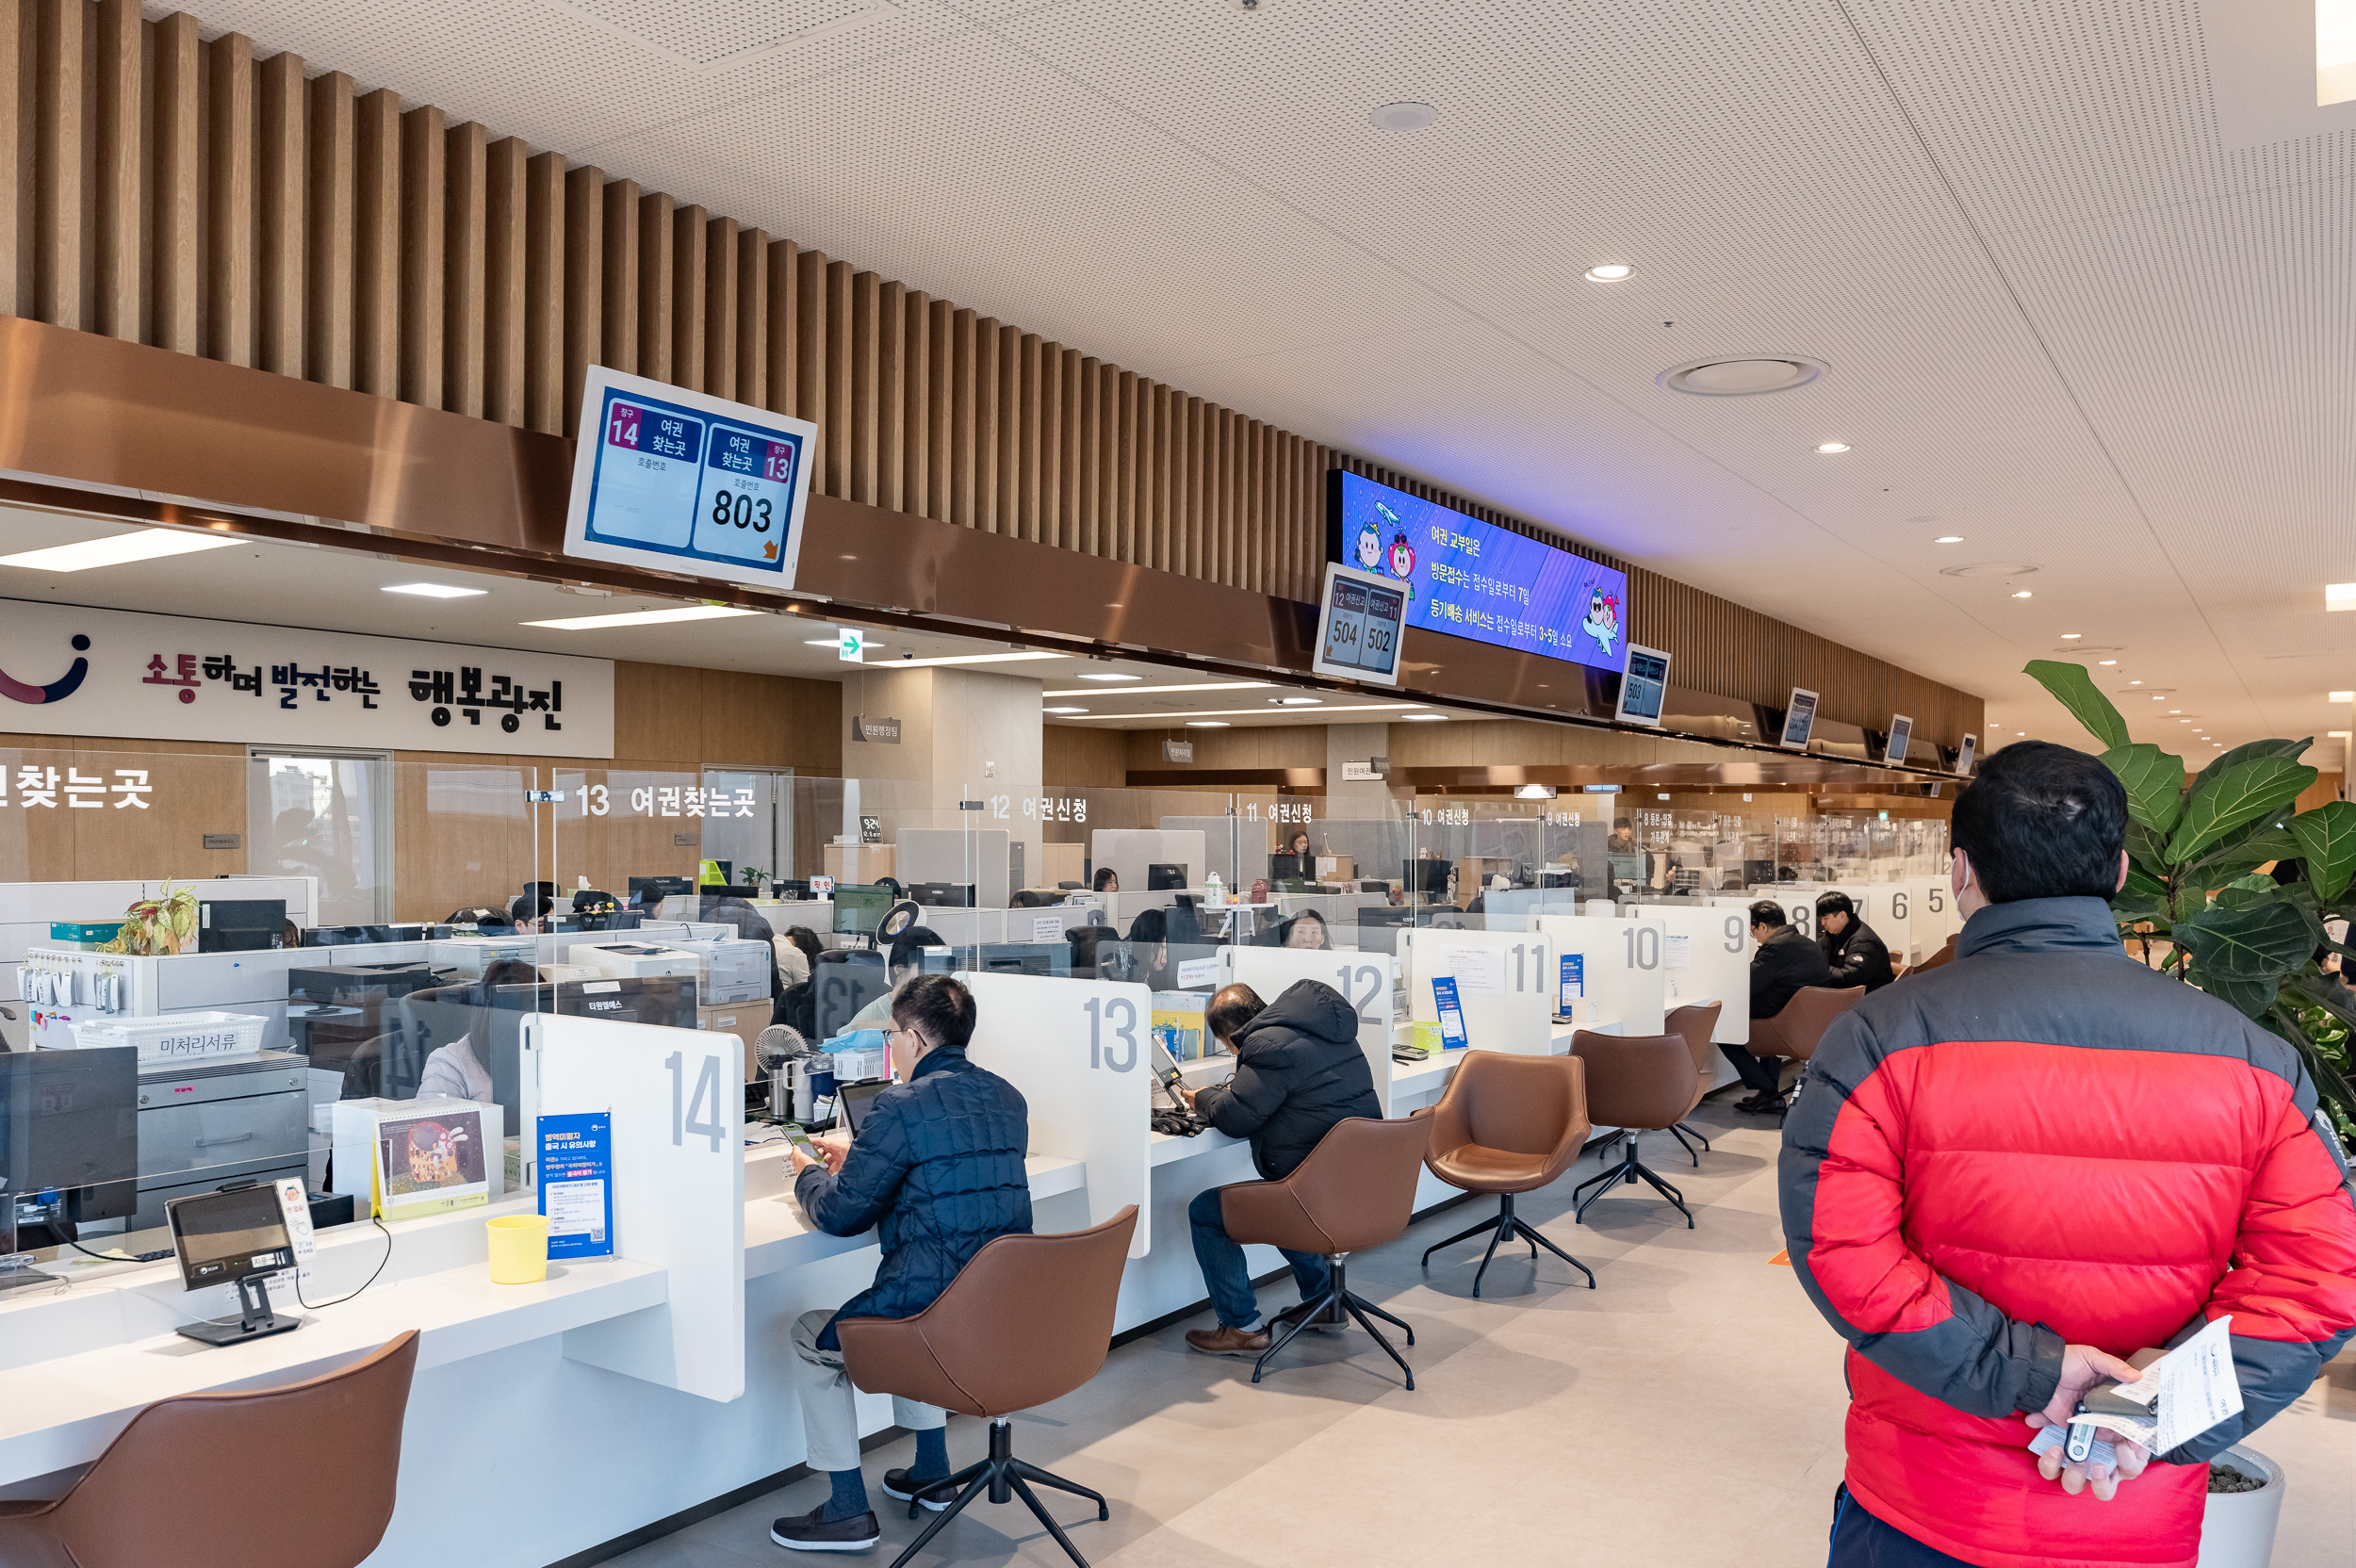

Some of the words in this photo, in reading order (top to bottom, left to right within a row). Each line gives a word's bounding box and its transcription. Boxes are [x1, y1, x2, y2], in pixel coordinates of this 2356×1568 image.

[621, 408, 634, 418] 창구
[613, 419, 638, 446] 14
[661, 419, 683, 438] 여권
[652, 435, 686, 457] 찾는곳
[729, 436, 750, 453] 여권
[774, 445, 786, 455] 창구
[637, 457, 666, 471] 호출번호
[722, 451, 753, 471] 찾는곳
[767, 456, 789, 480] 13
[733, 478, 760, 491] 호출번호
[712, 489, 773, 532] 803
[1431, 526, 1448, 547] 여권
[1449, 531, 1481, 557] 교부일은
[1431, 562, 1469, 589] 방문접수는
[1472, 573, 1516, 602] 접수일로부터
[1517, 587, 1530, 605] 7일
[1333, 592, 1345, 607] 12
[1389, 605, 1399, 619] 11
[1431, 598, 1463, 623] 등기배송
[1464, 608, 1495, 630] 서비스는
[1496, 614, 1537, 641] 접수일로부터
[1539, 626, 1558, 646] 3~5일
[1560, 631, 1573, 648] 소요
[1333, 619, 1358, 645] 504
[1367, 628, 1391, 652] 502
[142, 653, 262, 704] 소통하며
[271, 662, 381, 709] 발전하는
[408, 666, 562, 733] 행복광진
[1628, 682, 1642, 700] 503
[865, 725, 898, 737] 민원행정팀
[1348, 767, 1371, 776] 민원여권
[0, 764, 153, 809] 찾는곳
[576, 784, 610, 816] 13
[630, 786, 756, 818] 여권찾는곳
[990, 794, 1010, 819] 12
[1023, 796, 1087, 823] 여권신청
[1247, 803, 1258, 822] 11
[1268, 803, 1313, 824] 여권신청
[1422, 808, 1432, 825] 10
[1437, 808, 1469, 825] 여권신청
[1547, 810, 1553, 826] 9
[1556, 811, 1580, 827] 여권신청
[1644, 812, 1649, 826] 8
[1892, 892, 1907, 920] 6
[1929, 888, 1943, 913] 5
[1724, 915, 1744, 954] 9
[1792, 906, 1810, 939] 8
[1622, 927, 1659, 970] 10
[1512, 943, 1545, 993] 11
[1336, 965, 1383, 1025] 12
[160, 1034, 237, 1055] 미처리서류
[1084, 996, 1138, 1073] 13
[664, 1050, 727, 1154] 14
[545, 1132, 581, 1142] 병역미필자
[561, 1141, 568, 1150] 시
[568, 1139, 597, 1149] 유의사항
